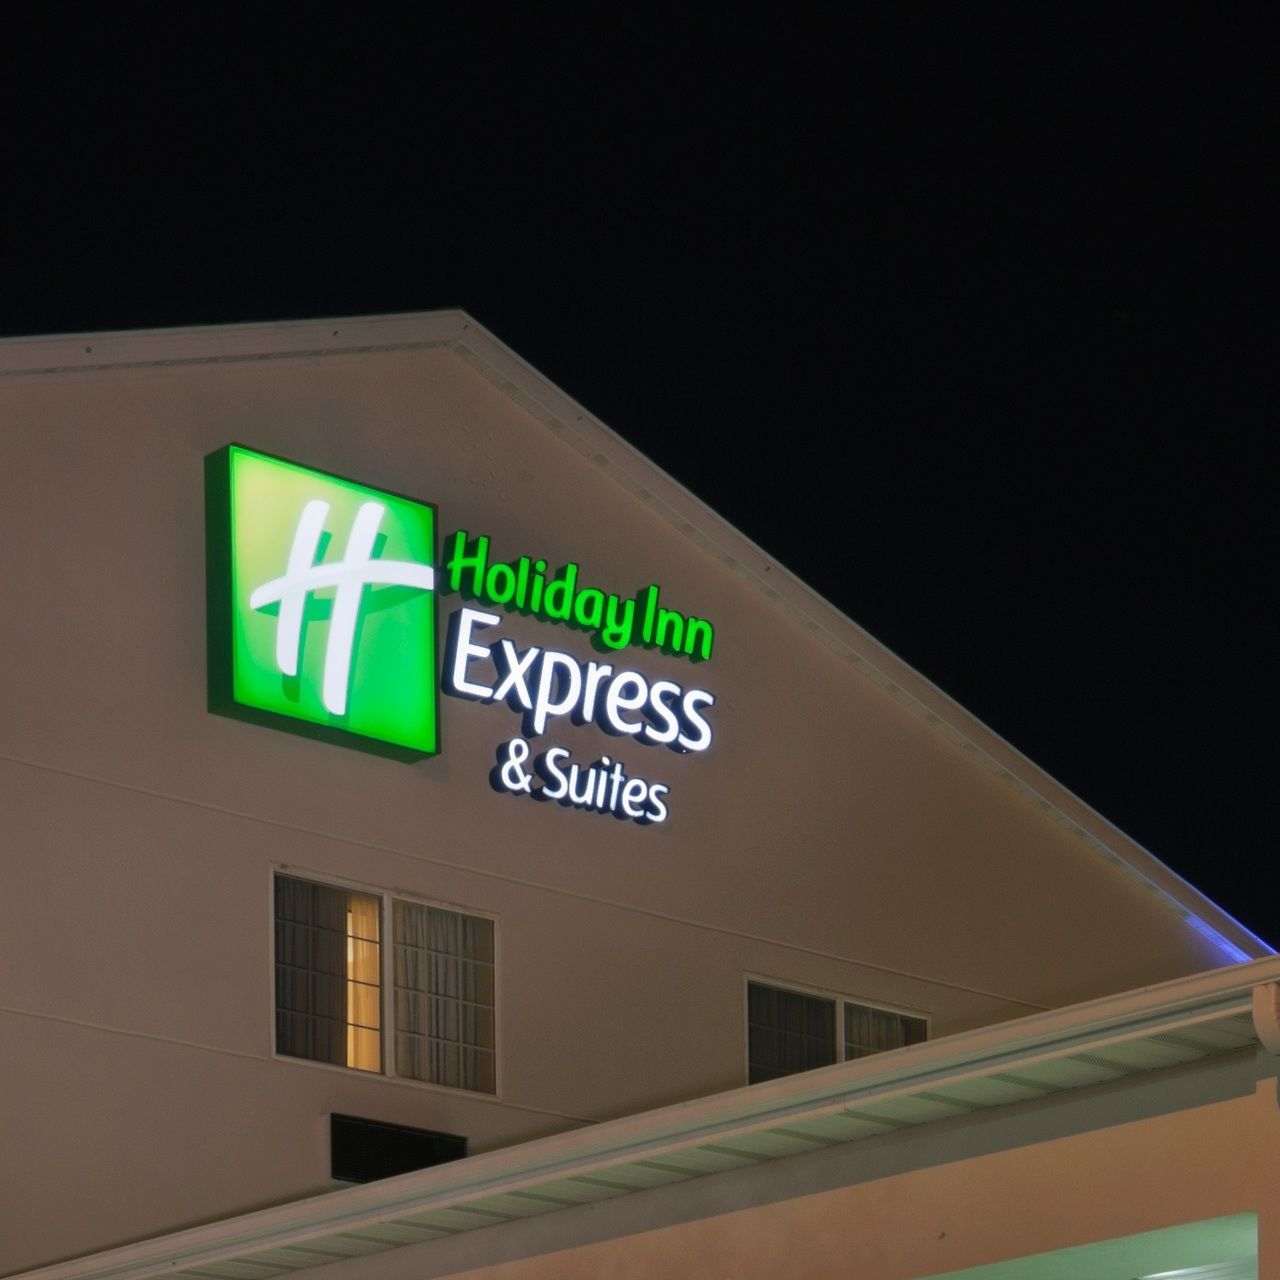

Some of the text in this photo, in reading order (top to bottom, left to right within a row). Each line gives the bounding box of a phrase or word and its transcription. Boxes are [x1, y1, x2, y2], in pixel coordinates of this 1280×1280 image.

[447, 530, 714, 660] Holiday Inn
[452, 607, 715, 753] Express
[500, 737, 669, 823] & Suites
